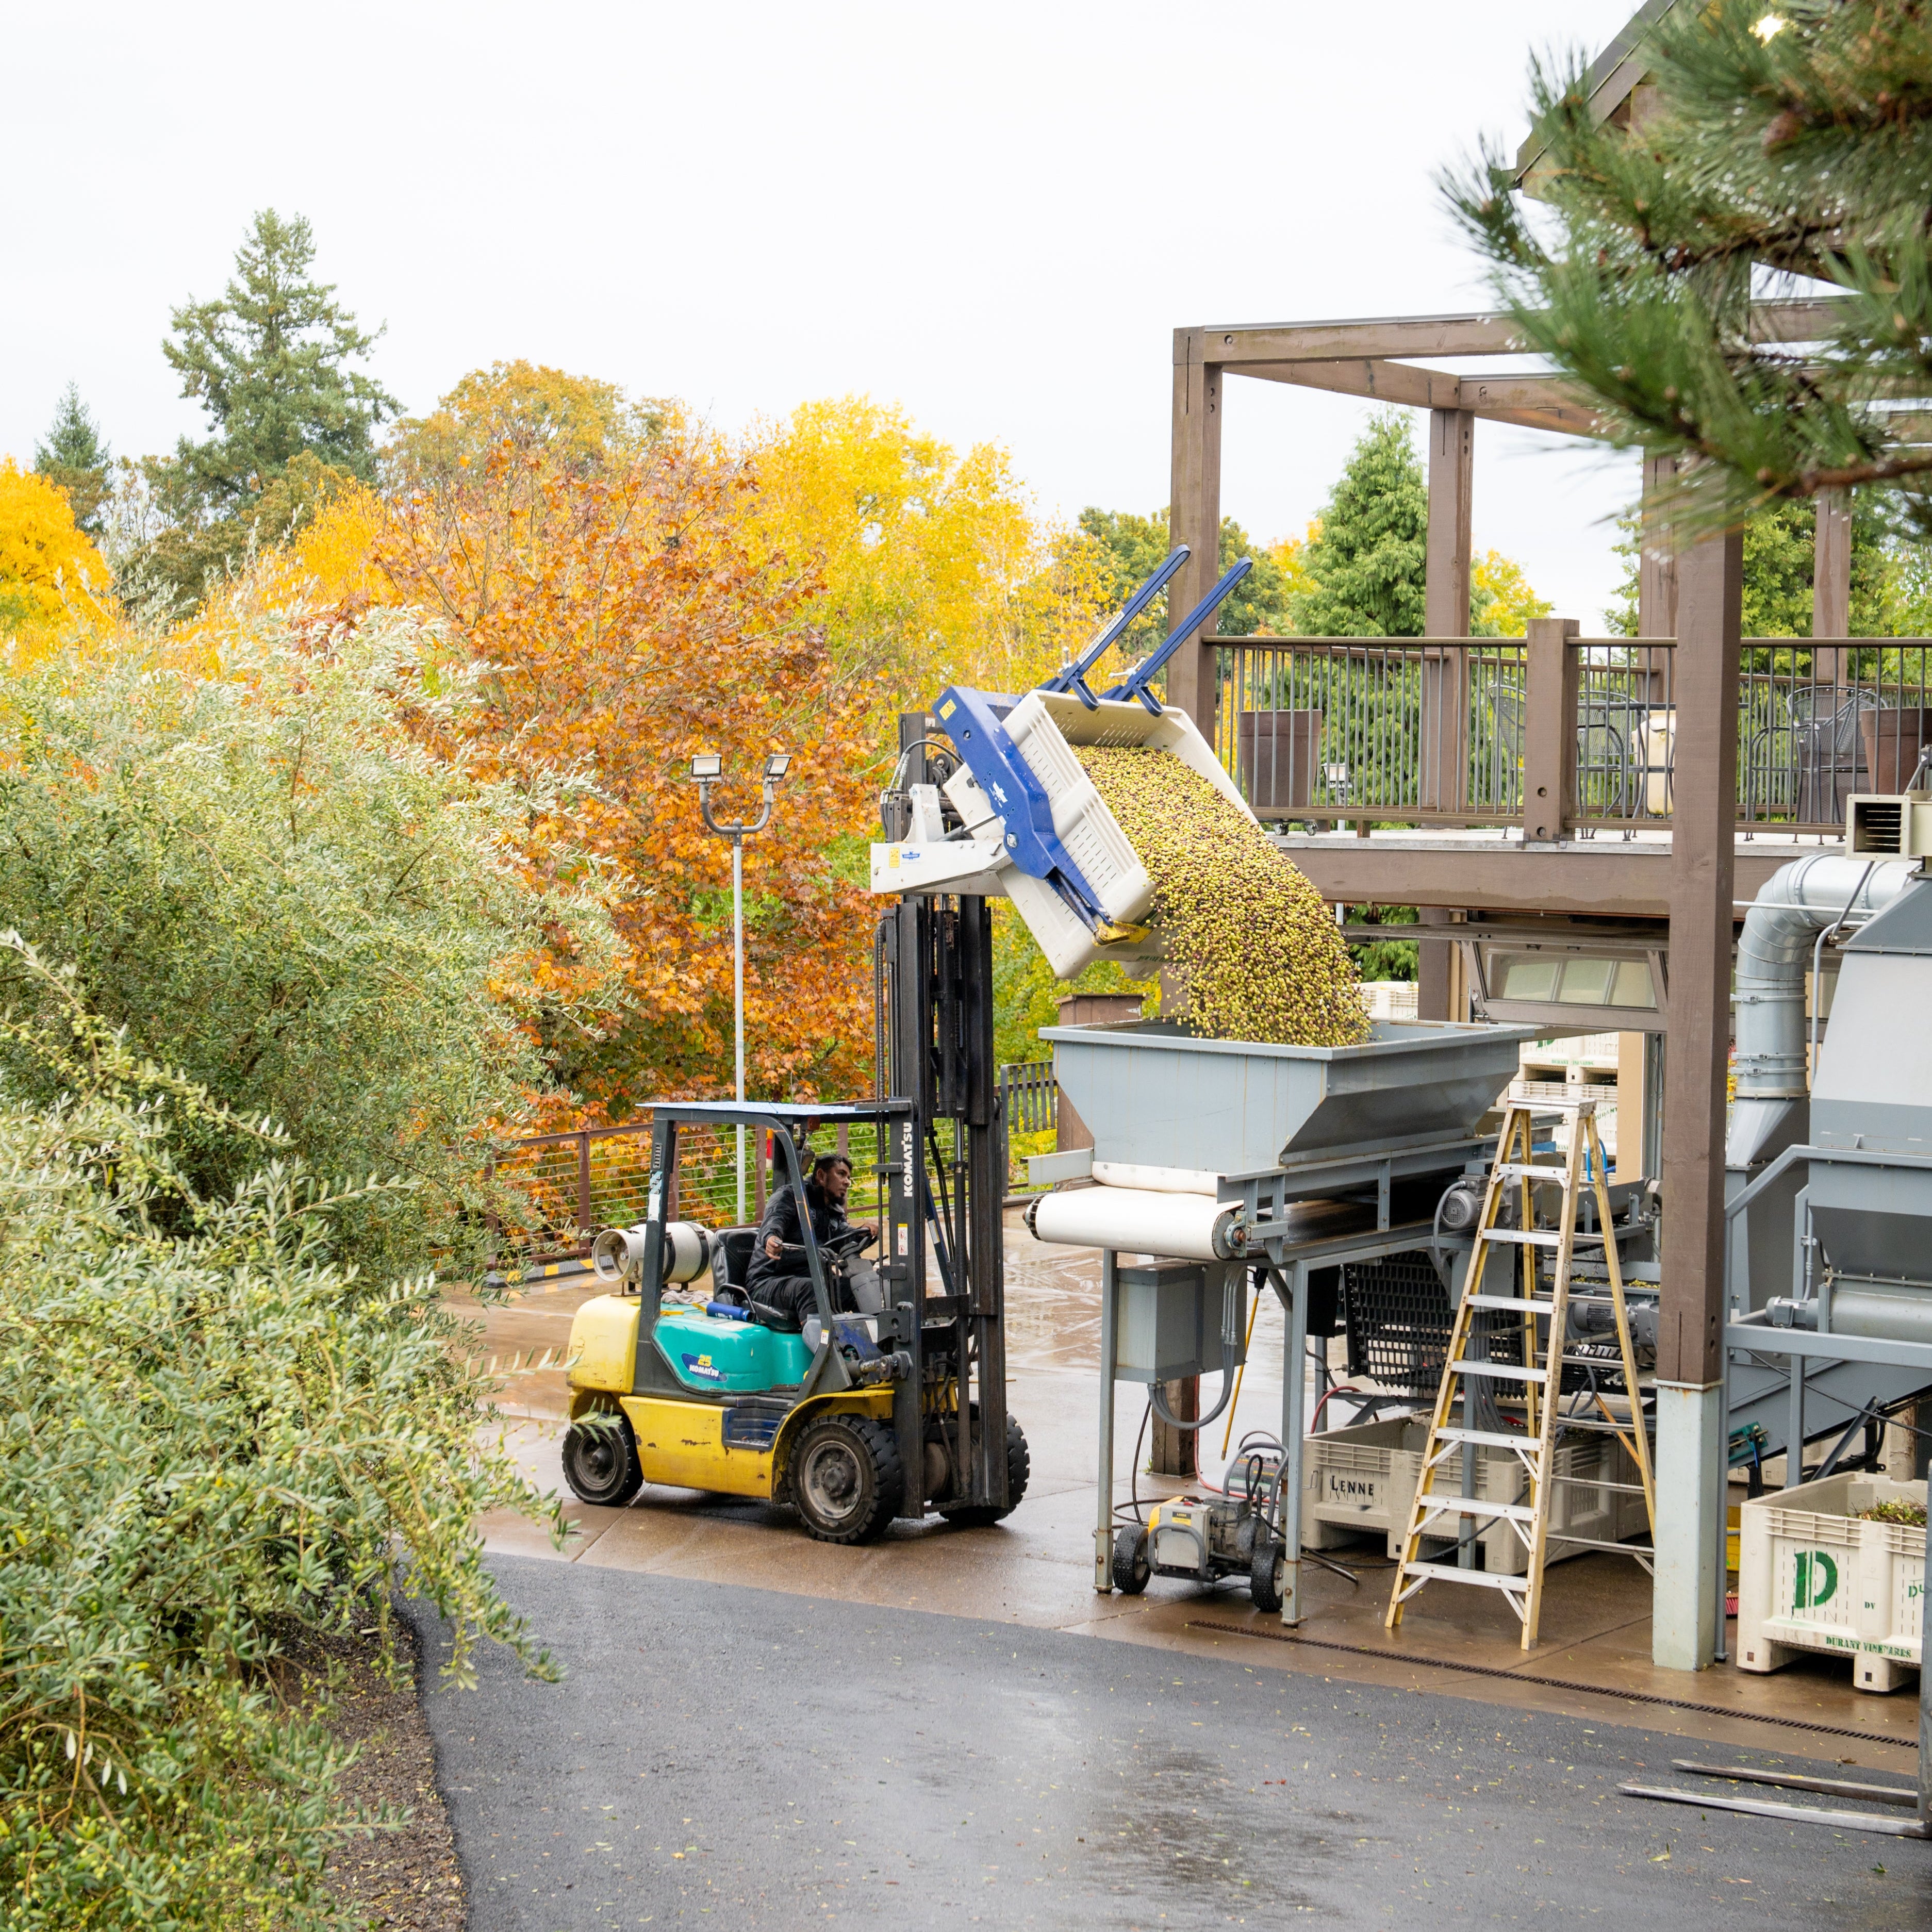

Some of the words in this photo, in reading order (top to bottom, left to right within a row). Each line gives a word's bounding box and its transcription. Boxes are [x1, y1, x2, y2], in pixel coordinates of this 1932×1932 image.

[901, 1122, 913, 1197] KOMATSU
[698, 1354, 712, 1367] 25
[689, 1364, 719, 1377] KOMATSU
[1332, 1475, 1374, 1496] LENNE
[1864, 1601, 1875, 1609] DV
[1826, 1636, 1861, 1650] DURANT
